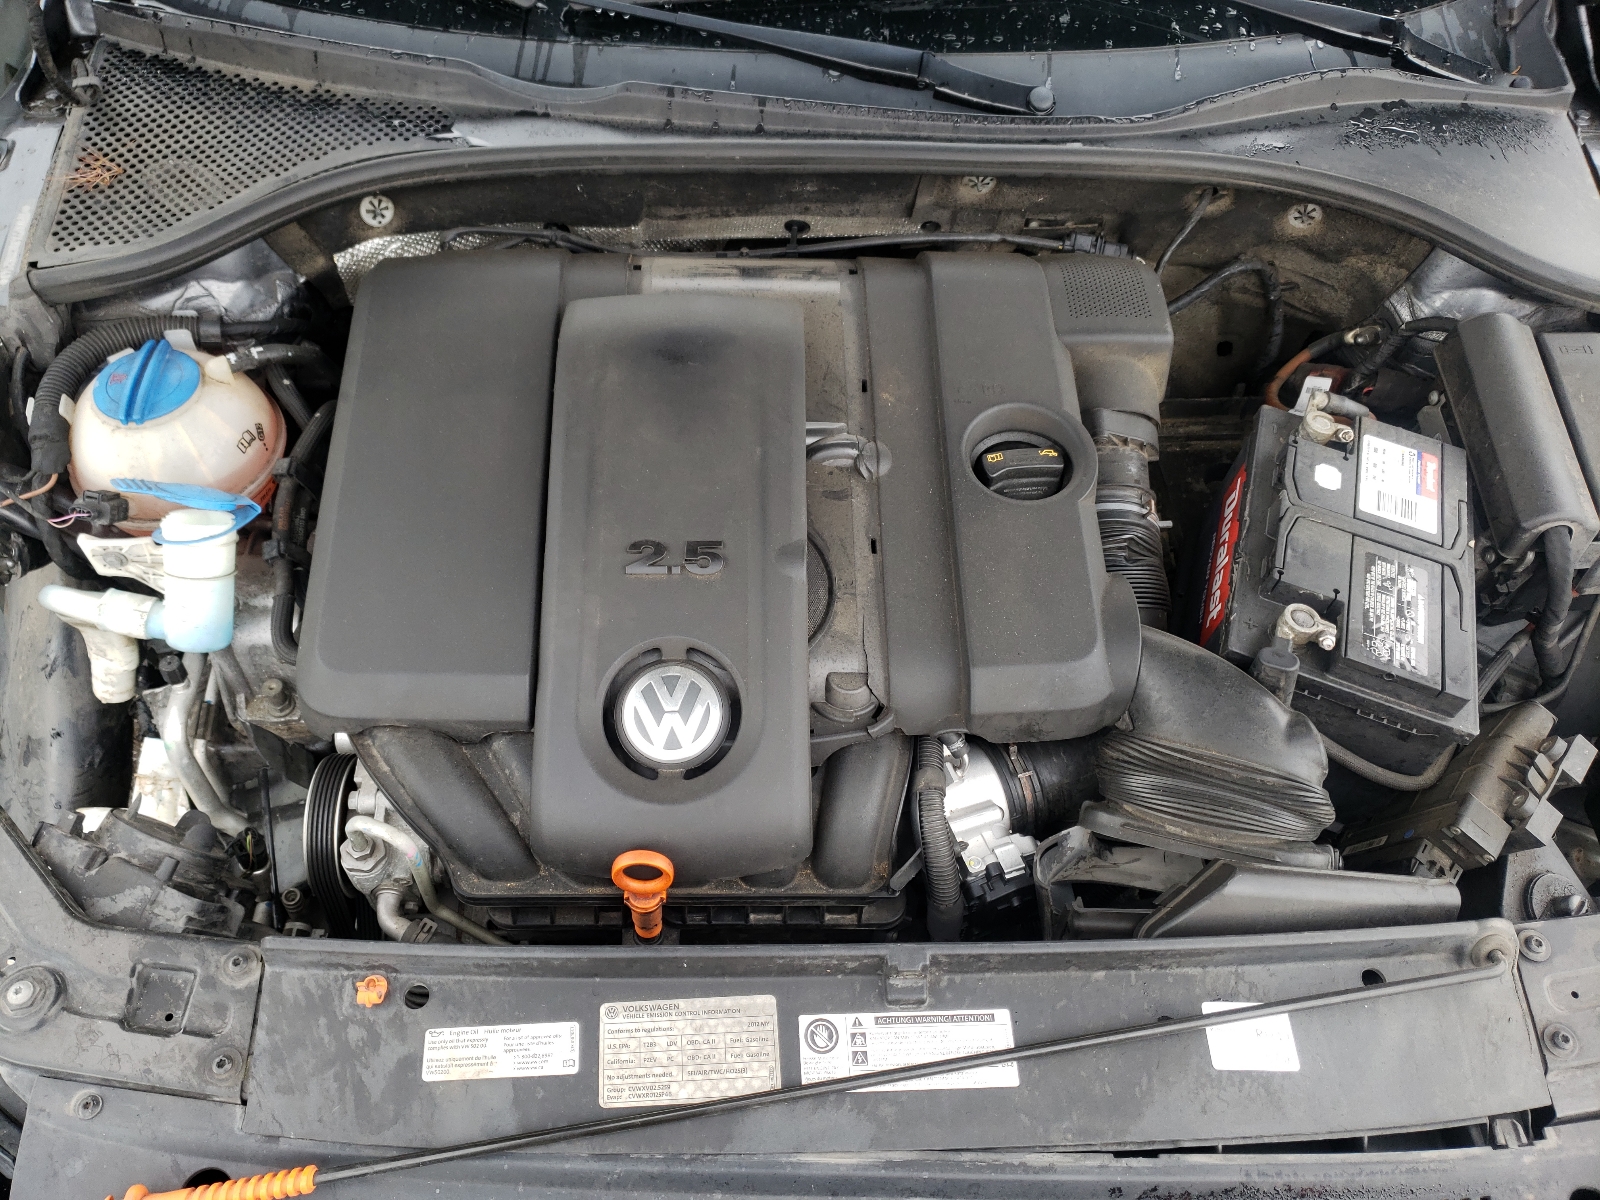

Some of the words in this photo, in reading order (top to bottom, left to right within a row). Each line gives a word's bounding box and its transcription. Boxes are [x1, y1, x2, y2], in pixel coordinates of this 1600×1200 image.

[625, 539, 725, 575] 2.5
[1206, 477, 1241, 629] Duralast
[622, 1003, 680, 1013] VOLKSWAGEN
[701, 1008, 741, 1016] INFORMATION
[877, 1016, 914, 1025] ACHTUNG!
[915, 1015, 951, 1024] WARNING!
[952, 1014, 993, 1022] ATTENTION!
[449, 1029, 470, 1038] Engine
[500, 1026, 522, 1034] moteur
[641, 1026, 675, 1034] regulations:
[745, 1035, 769, 1043] Gasoline
[606, 1057, 636, 1065] California:
[615, 1072, 651, 1081] adjustments
